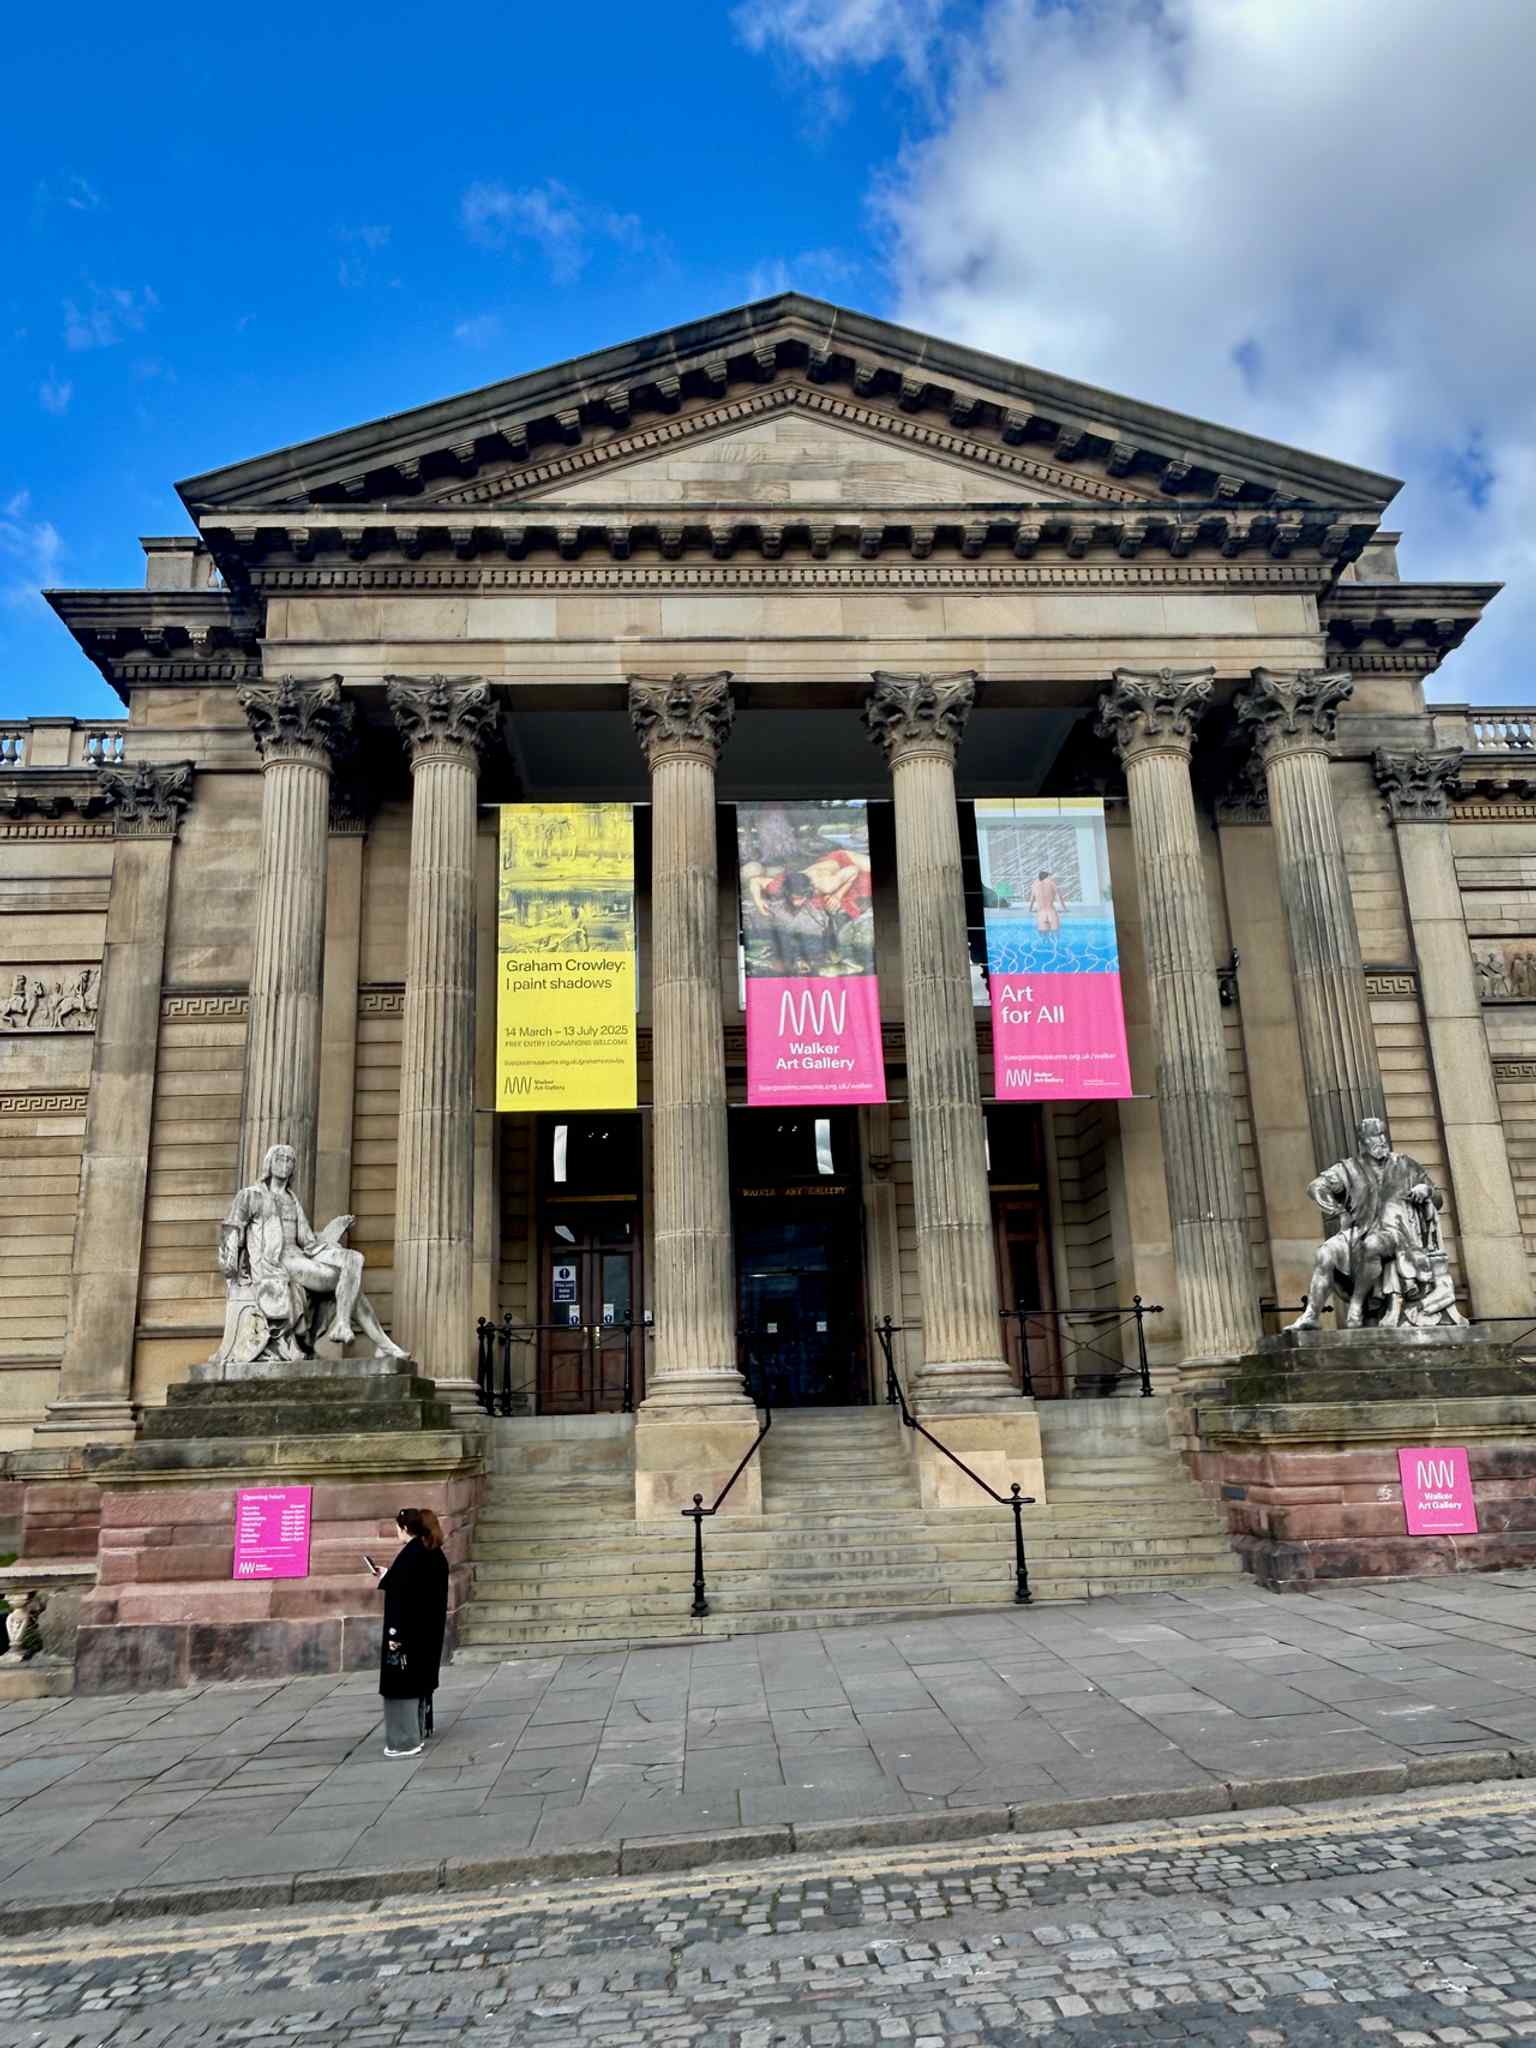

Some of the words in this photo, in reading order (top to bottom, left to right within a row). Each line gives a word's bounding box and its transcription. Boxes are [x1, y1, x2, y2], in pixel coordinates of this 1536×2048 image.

[506, 959, 562, 972] Graham
[565, 958, 626, 973] Crowley:
[506, 978, 510, 990] I
[513, 978, 547, 992] paint
[550, 977, 613, 990] shadows
[1000, 984, 1033, 1003] Art
[1001, 1006, 1032, 1023] for
[1036, 1005, 1064, 1023] All
[505, 1027, 516, 1037] 14
[519, 1026, 552, 1037] March
[564, 1026, 575, 1036] 13
[576, 1025, 598, 1037] July
[600, 1025, 629, 1036] 2025
[789, 1042, 840, 1054] Walker
[776, 1058, 799, 1070] Art
[802, 1057, 855, 1071] Gallery
[1424, 1492, 1453, 1501] Walker
[1418, 1502, 1431, 1510] Art
[1432, 1501, 1462, 1511] Gallery
